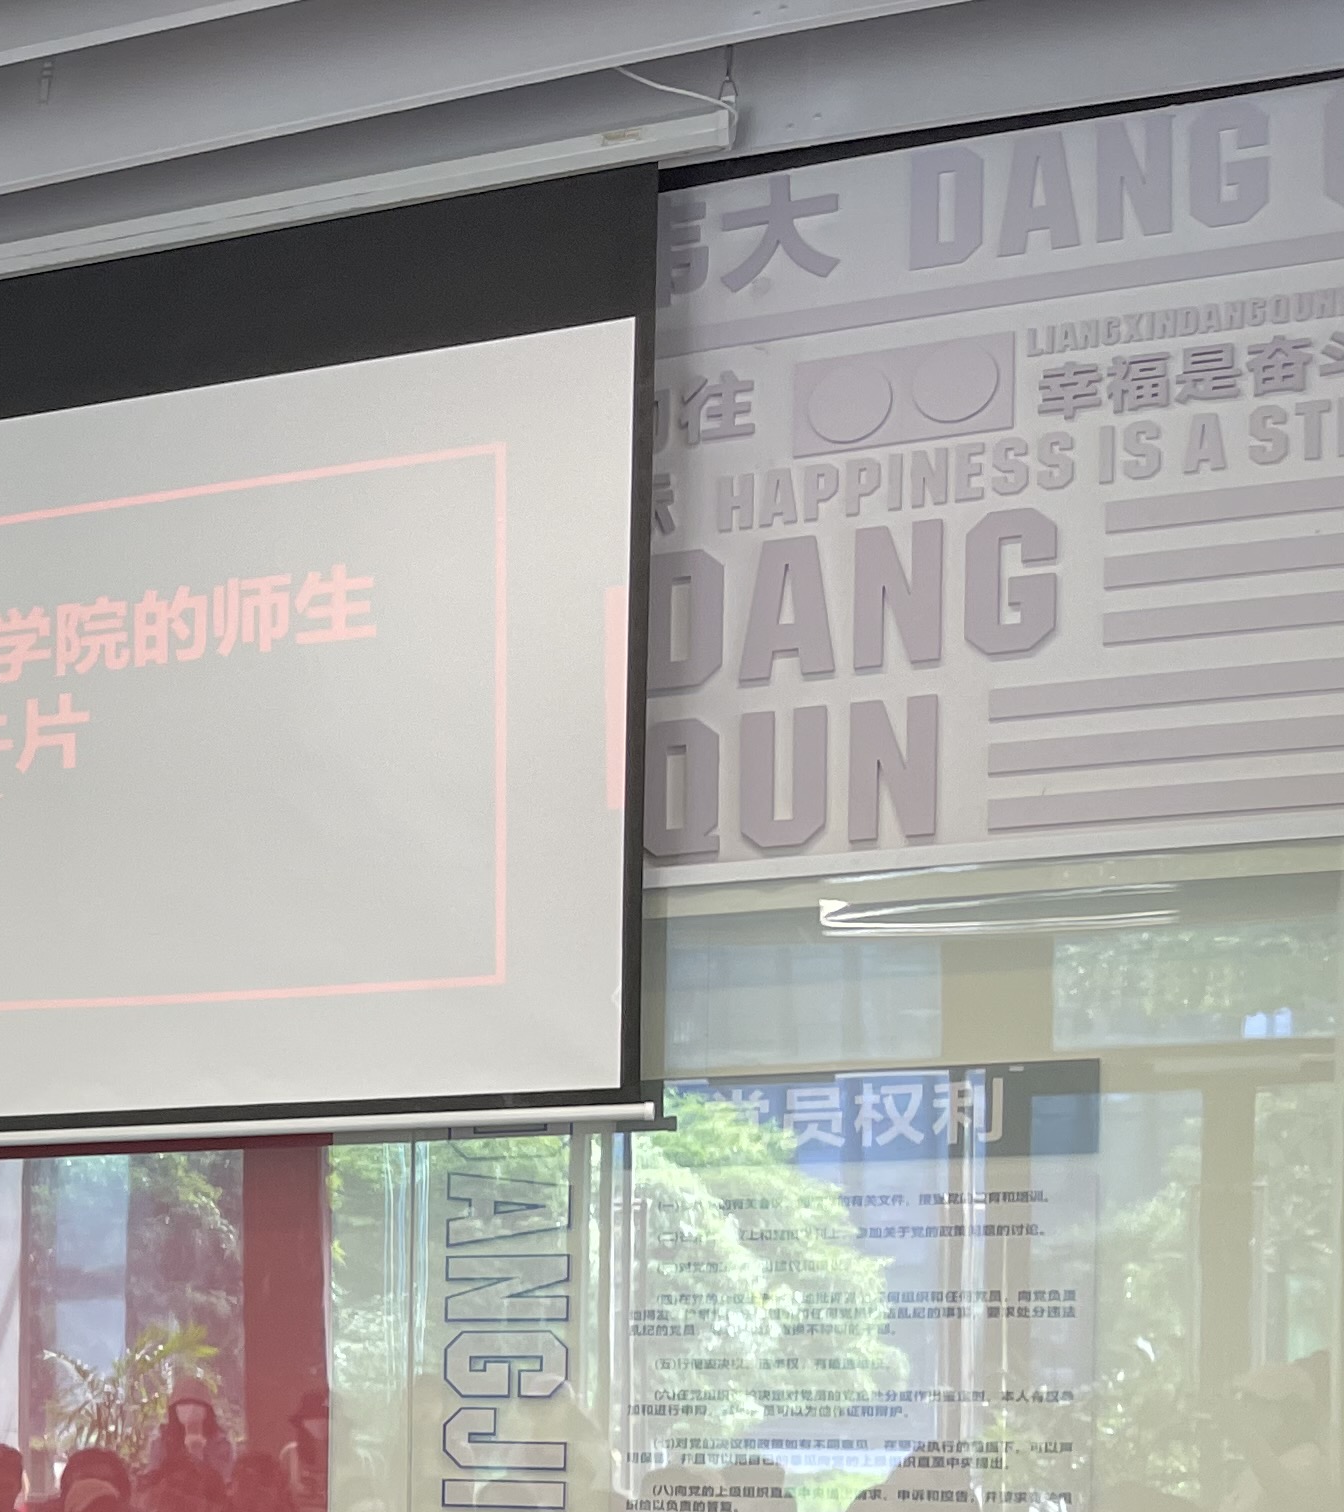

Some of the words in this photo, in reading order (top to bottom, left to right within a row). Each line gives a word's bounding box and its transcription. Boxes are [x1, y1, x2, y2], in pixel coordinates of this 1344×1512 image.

[908, 101, 1270, 271] DANG
[1027, 287, 1344, 357] LIANGXINDANGQUN
[717, 431, 1075, 533] HAPPINESS
[1098, 419, 1163, 485] IS
[1183, 412, 1227, 475] A
[1248, 396, 1344, 466] ST
[646, 507, 1058, 697] DANG
[643, 694, 939, 858] QUN
